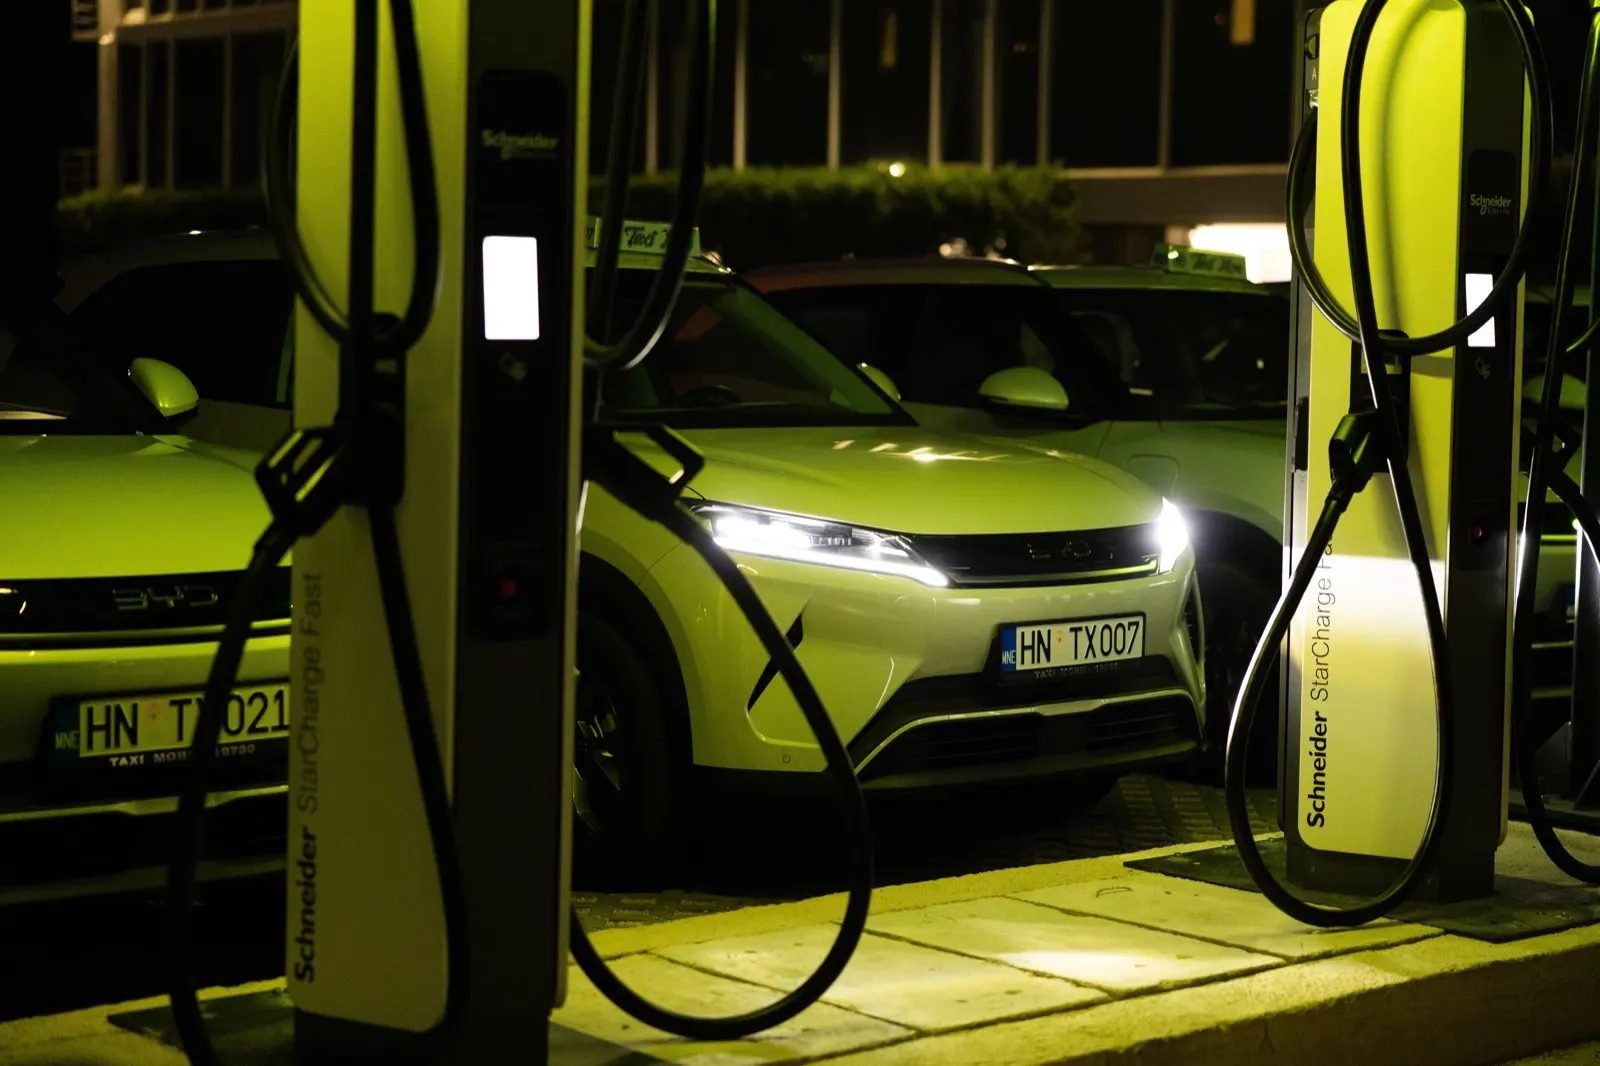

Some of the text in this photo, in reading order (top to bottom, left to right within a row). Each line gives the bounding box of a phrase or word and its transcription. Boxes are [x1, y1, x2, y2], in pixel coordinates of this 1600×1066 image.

[1470, 194, 1512, 208] Schneider
[1002, 650, 1016, 665] MNE
[1020, 620, 1140, 665] HN TX007
[1311, 578, 1335, 702] StarCharge
[55, 730, 79, 750] MNE
[86, 690, 290, 749] HN T021
[108, 755, 145, 767] TAXI
[294, 573, 325, 983] Schneider StarCharge Fast
[1307, 711, 1329, 828] Schneider
